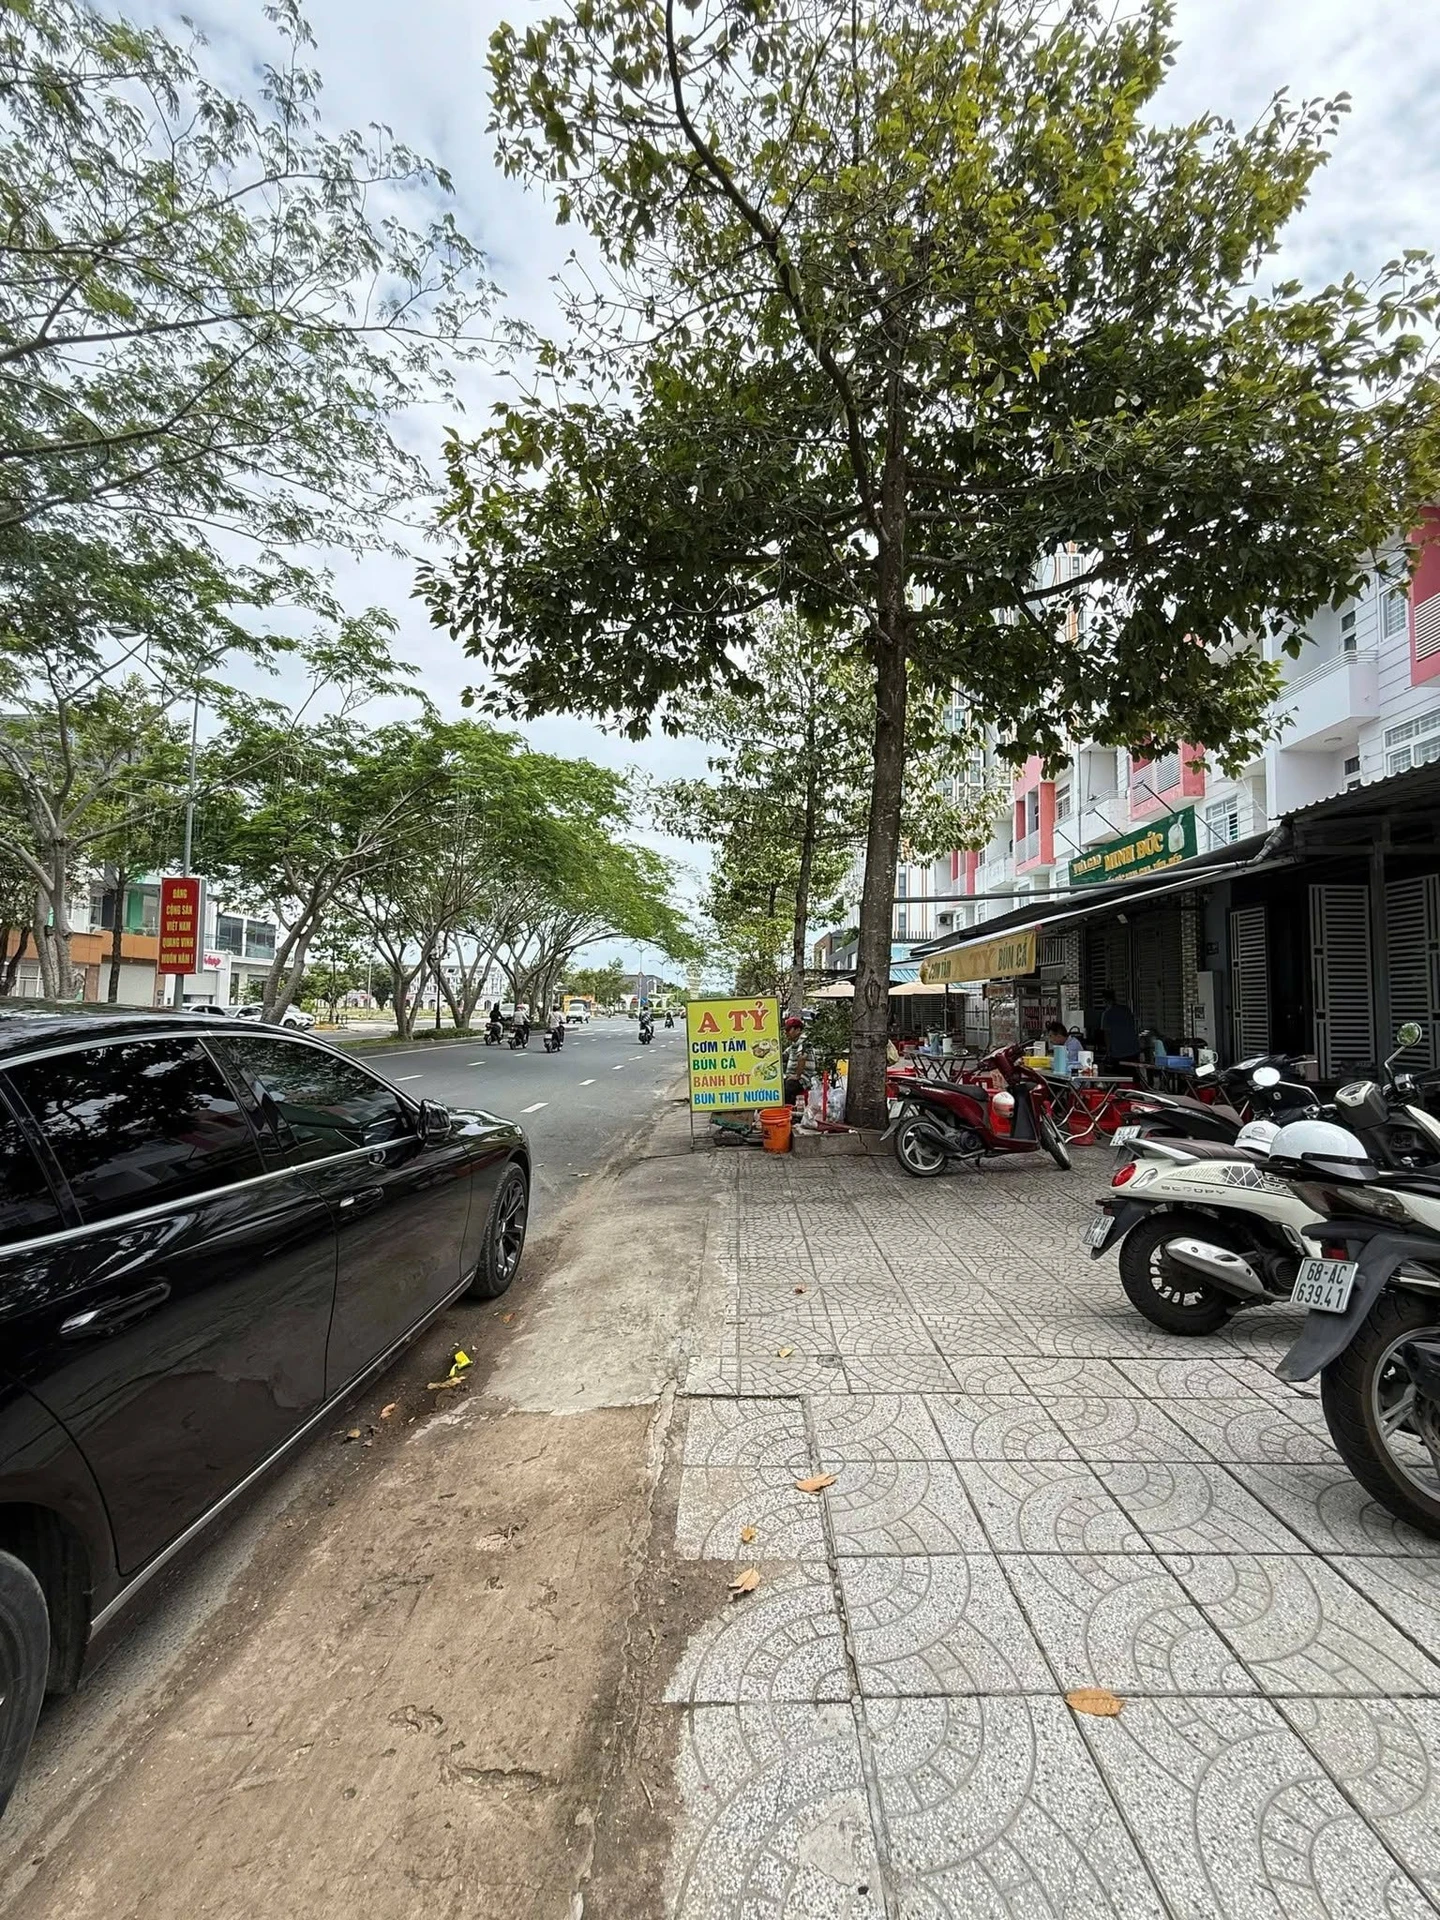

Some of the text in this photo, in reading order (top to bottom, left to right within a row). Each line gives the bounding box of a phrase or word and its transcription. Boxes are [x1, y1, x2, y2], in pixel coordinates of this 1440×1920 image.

[1104, 844, 1135, 871] MINH
[1135, 831, 1164, 860] ĐỨC
[166, 919, 191, 932] VIỆT NAM
[997, 942, 1014, 971] BÚN
[1016, 937, 1028, 968] CÁ
[697, 1000, 769, 1034] A TỶ
[692, 1036, 747, 1054] CƠM TẤM
[692, 1055, 736, 1071] BÚN CÁ
[693, 1072, 751, 1088] BÁNH ƯỚT
[694, 1089, 780, 1106] BÚN THỊT NƯỚNG
[1307, 1262, 1347, 1285] 68-AC
[1296, 1283, 1344, 1309] 639.41
